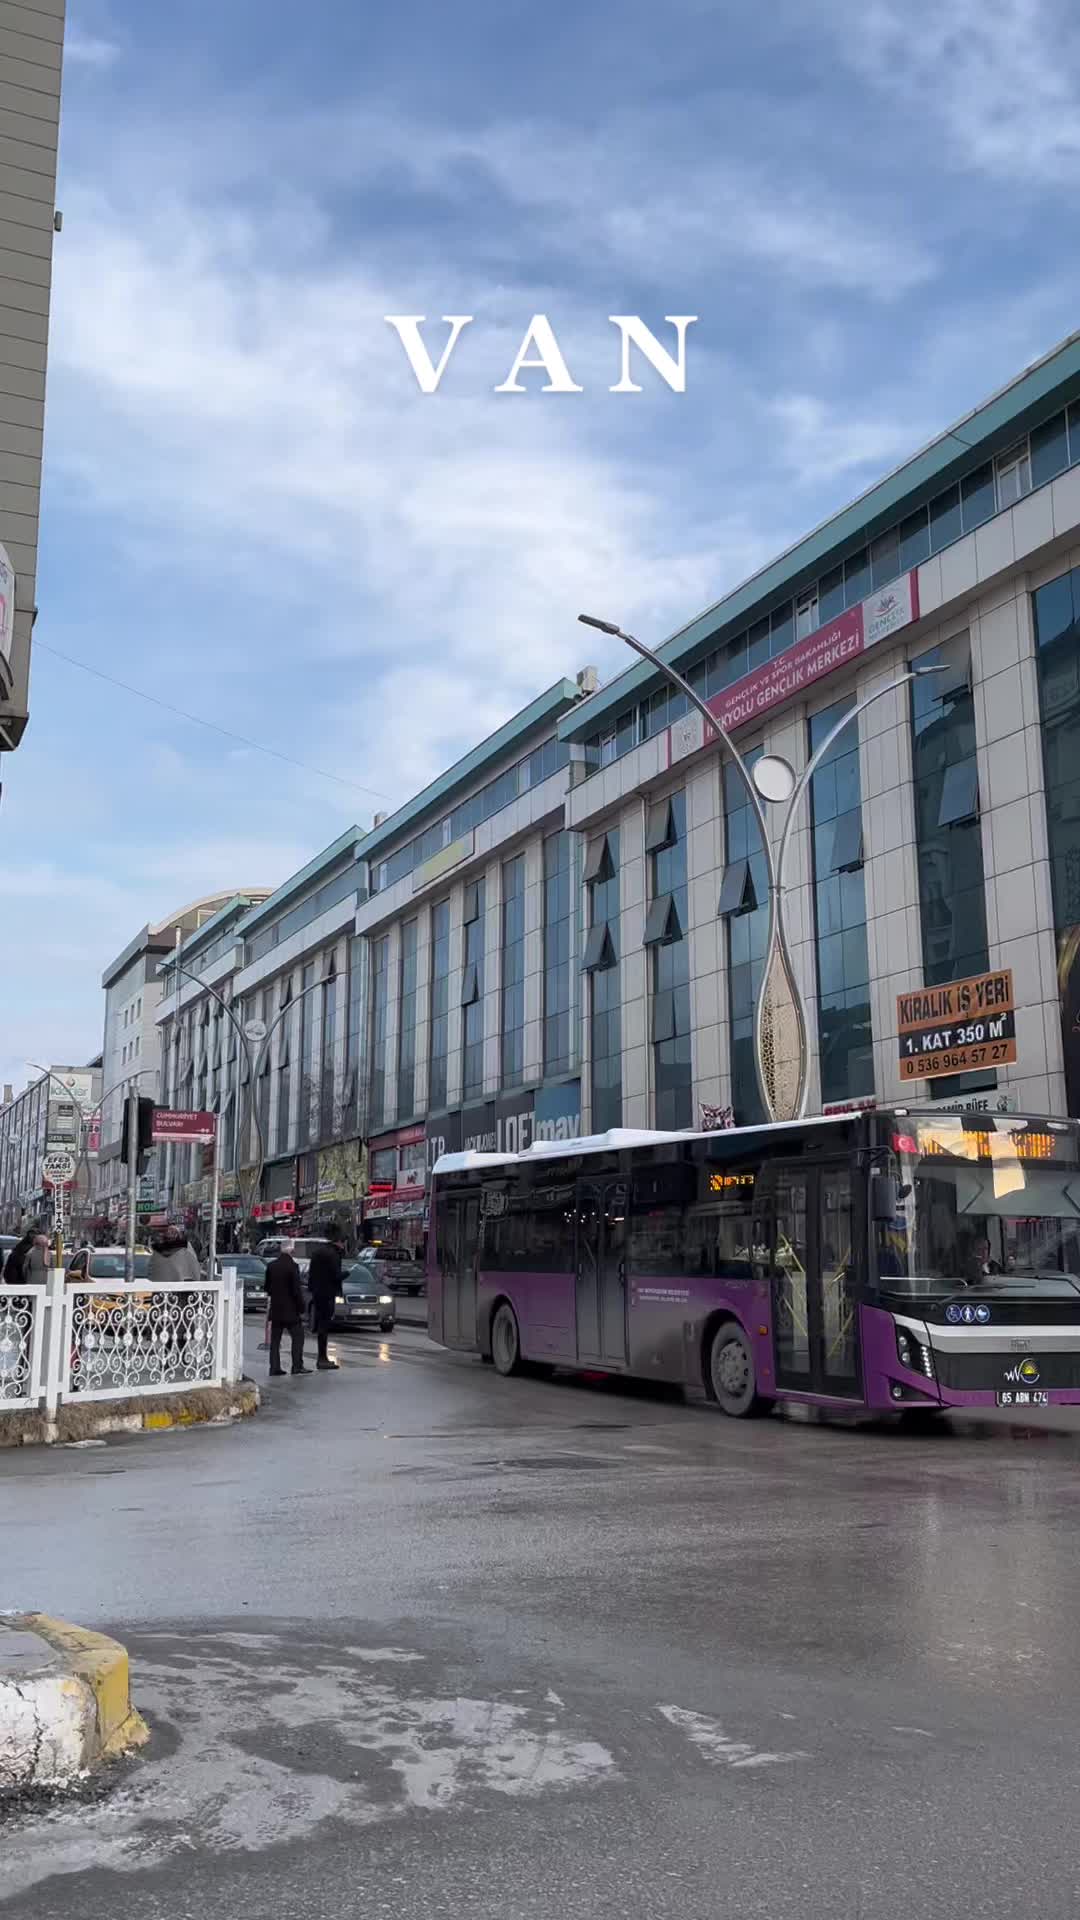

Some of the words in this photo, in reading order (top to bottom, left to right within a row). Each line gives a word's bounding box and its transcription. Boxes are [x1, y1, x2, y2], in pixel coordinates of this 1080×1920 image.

[807, 628, 860, 677] MERKEZİ
[772, 661, 793, 679] SPOR
[975, 976, 1009, 1006] YERİ
[906, 1038, 918, 1053] 1.
[922, 1031, 952, 1051] KAT
[957, 1024, 984, 1045] 350
[907, 1060, 913, 1074] 0
[917, 1057, 939, 1073] 536
[943, 1051, 967, 1068] 964
[971, 1048, 986, 1063] 57
[992, 1044, 1008, 1060] 27
